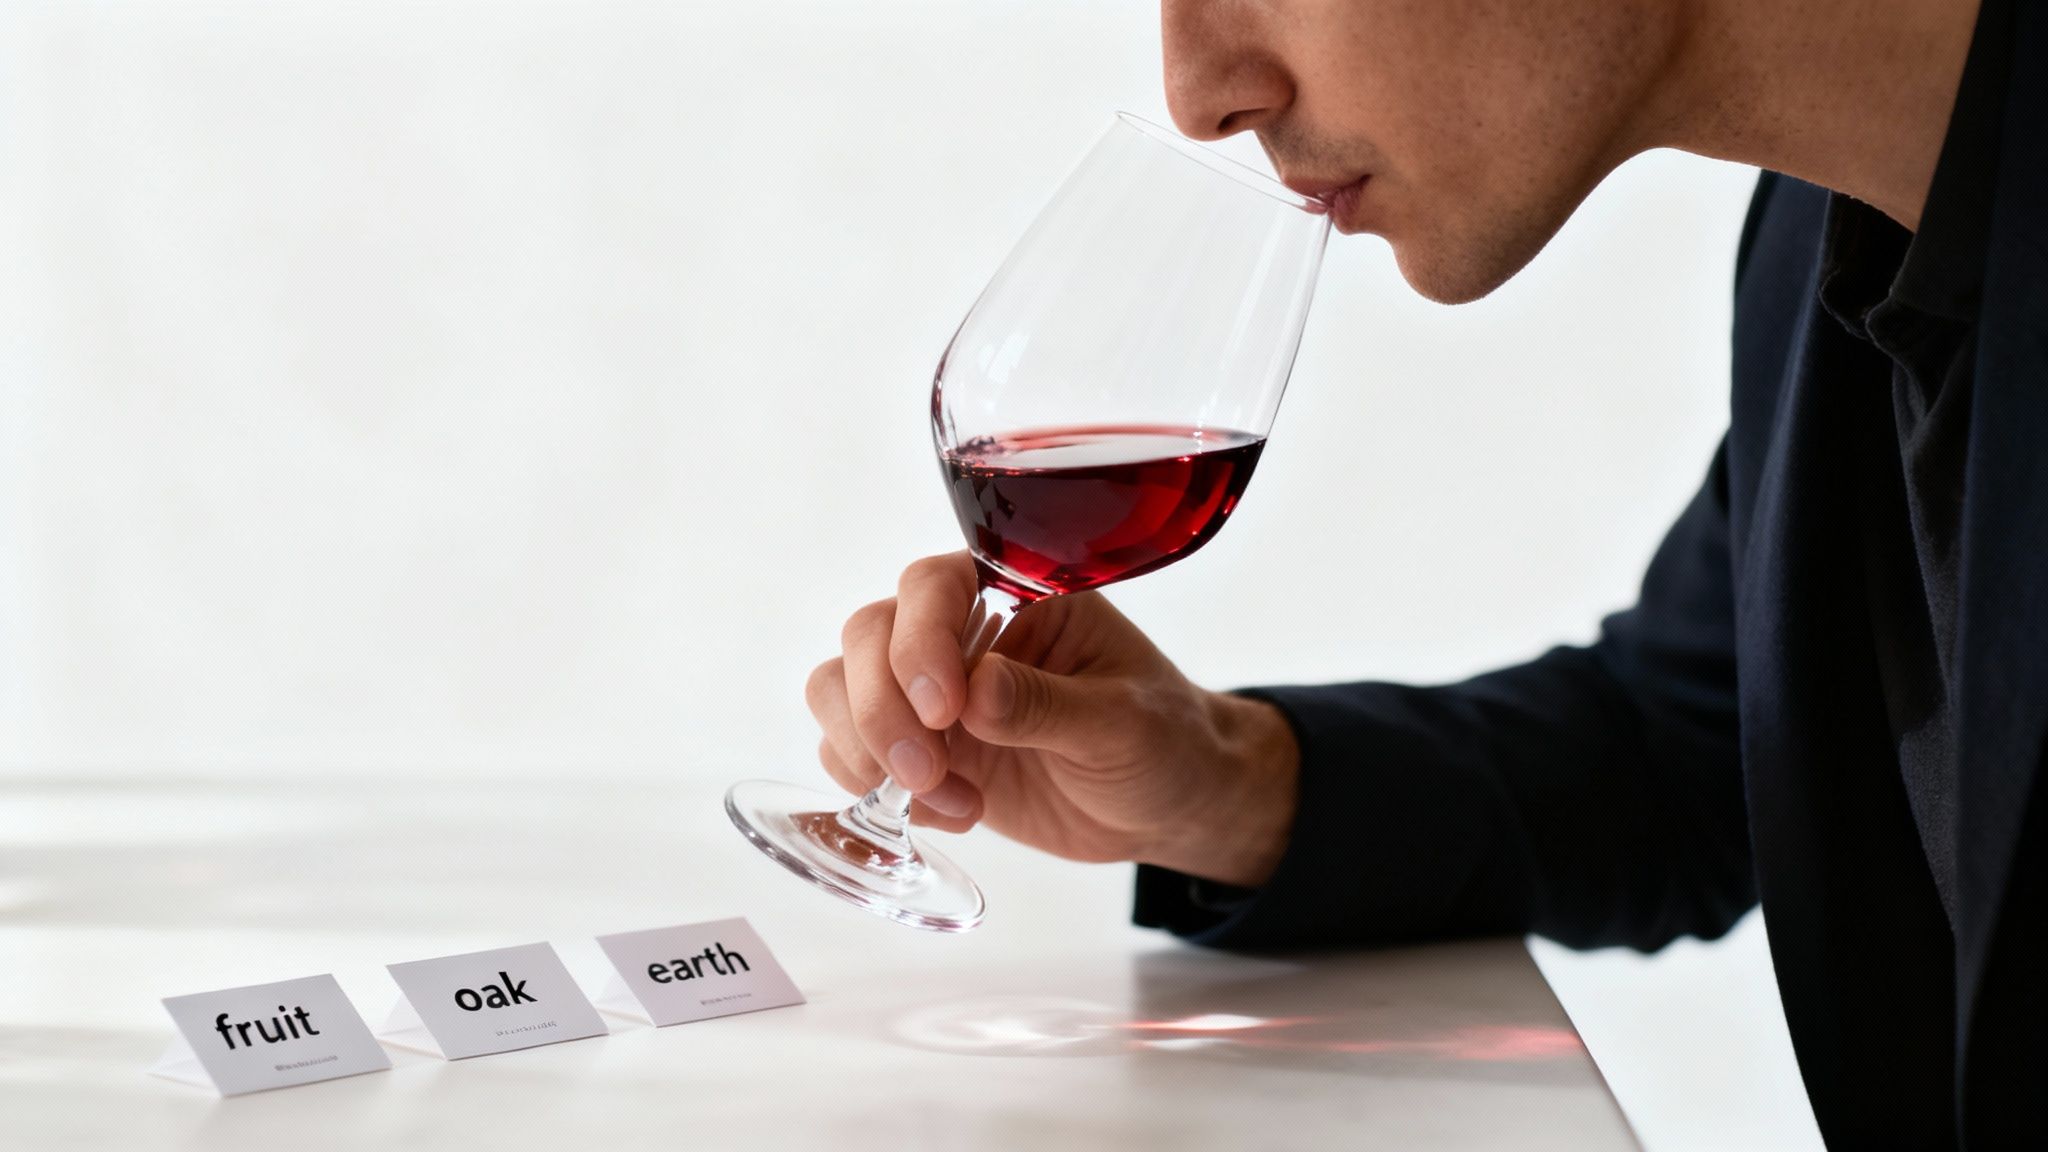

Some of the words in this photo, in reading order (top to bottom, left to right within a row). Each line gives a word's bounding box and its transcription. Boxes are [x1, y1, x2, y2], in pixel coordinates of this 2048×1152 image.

[647, 942, 751, 984] earth
[454, 971, 538, 1012] oak
[215, 1005, 321, 1050] fruit
